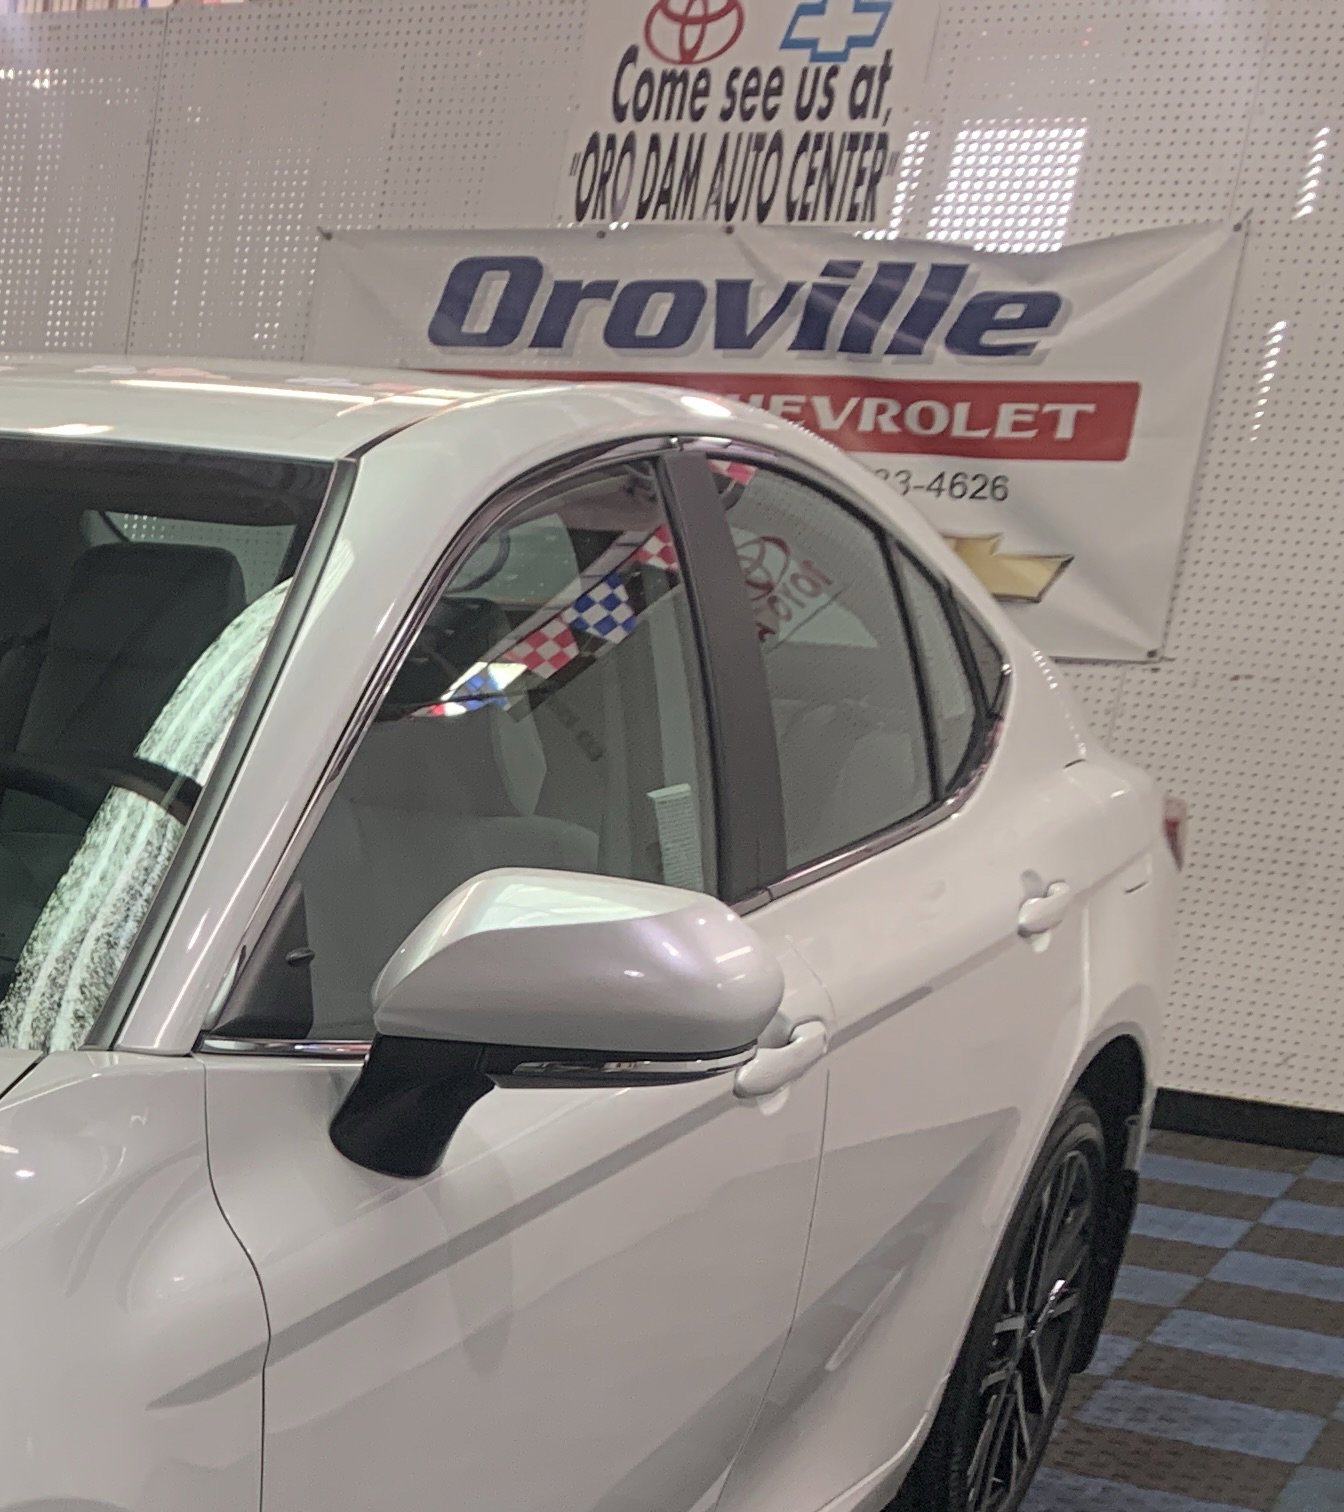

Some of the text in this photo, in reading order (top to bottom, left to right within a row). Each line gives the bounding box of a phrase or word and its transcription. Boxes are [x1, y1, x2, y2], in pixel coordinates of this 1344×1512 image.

[612, 43, 712, 123] Come
[720, 65, 785, 122] see
[795, 64, 841, 122] us
[635, 132, 708, 222] DAM
[703, 129, 785, 224] AUTO
[427, 255, 1066, 361] Oroville
